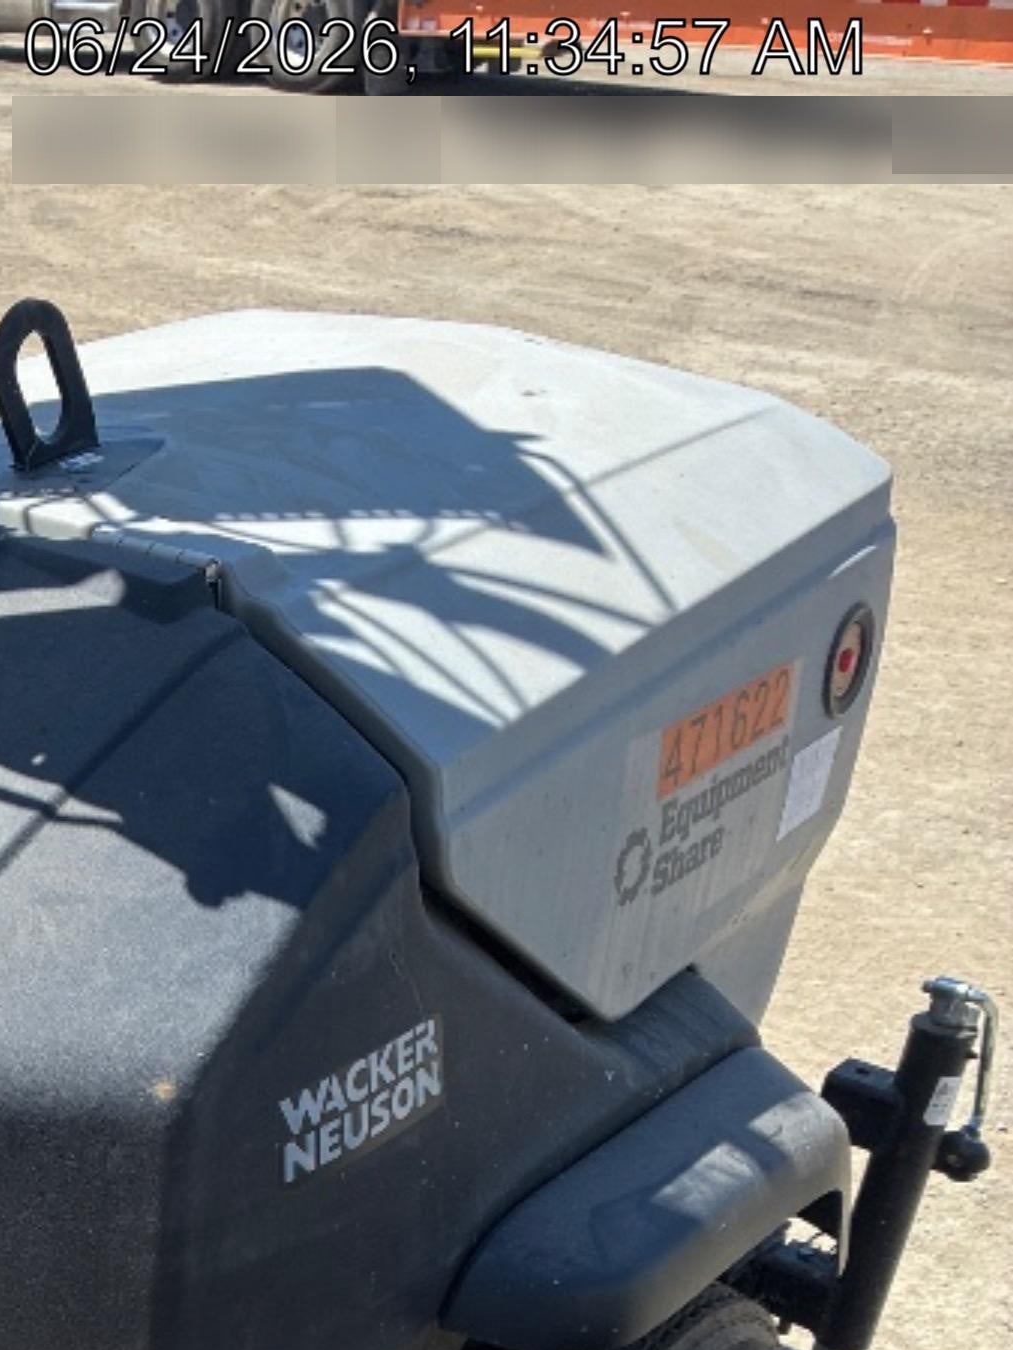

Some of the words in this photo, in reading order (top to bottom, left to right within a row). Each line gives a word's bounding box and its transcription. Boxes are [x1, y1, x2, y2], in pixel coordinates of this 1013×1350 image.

[662, 668, 790, 787] 471622
[660, 736, 790, 845] Equipment
[650, 824, 726, 897] Share
[279, 1019, 439, 1135] WACKER
[284, 1061, 441, 1183] NEUSON
